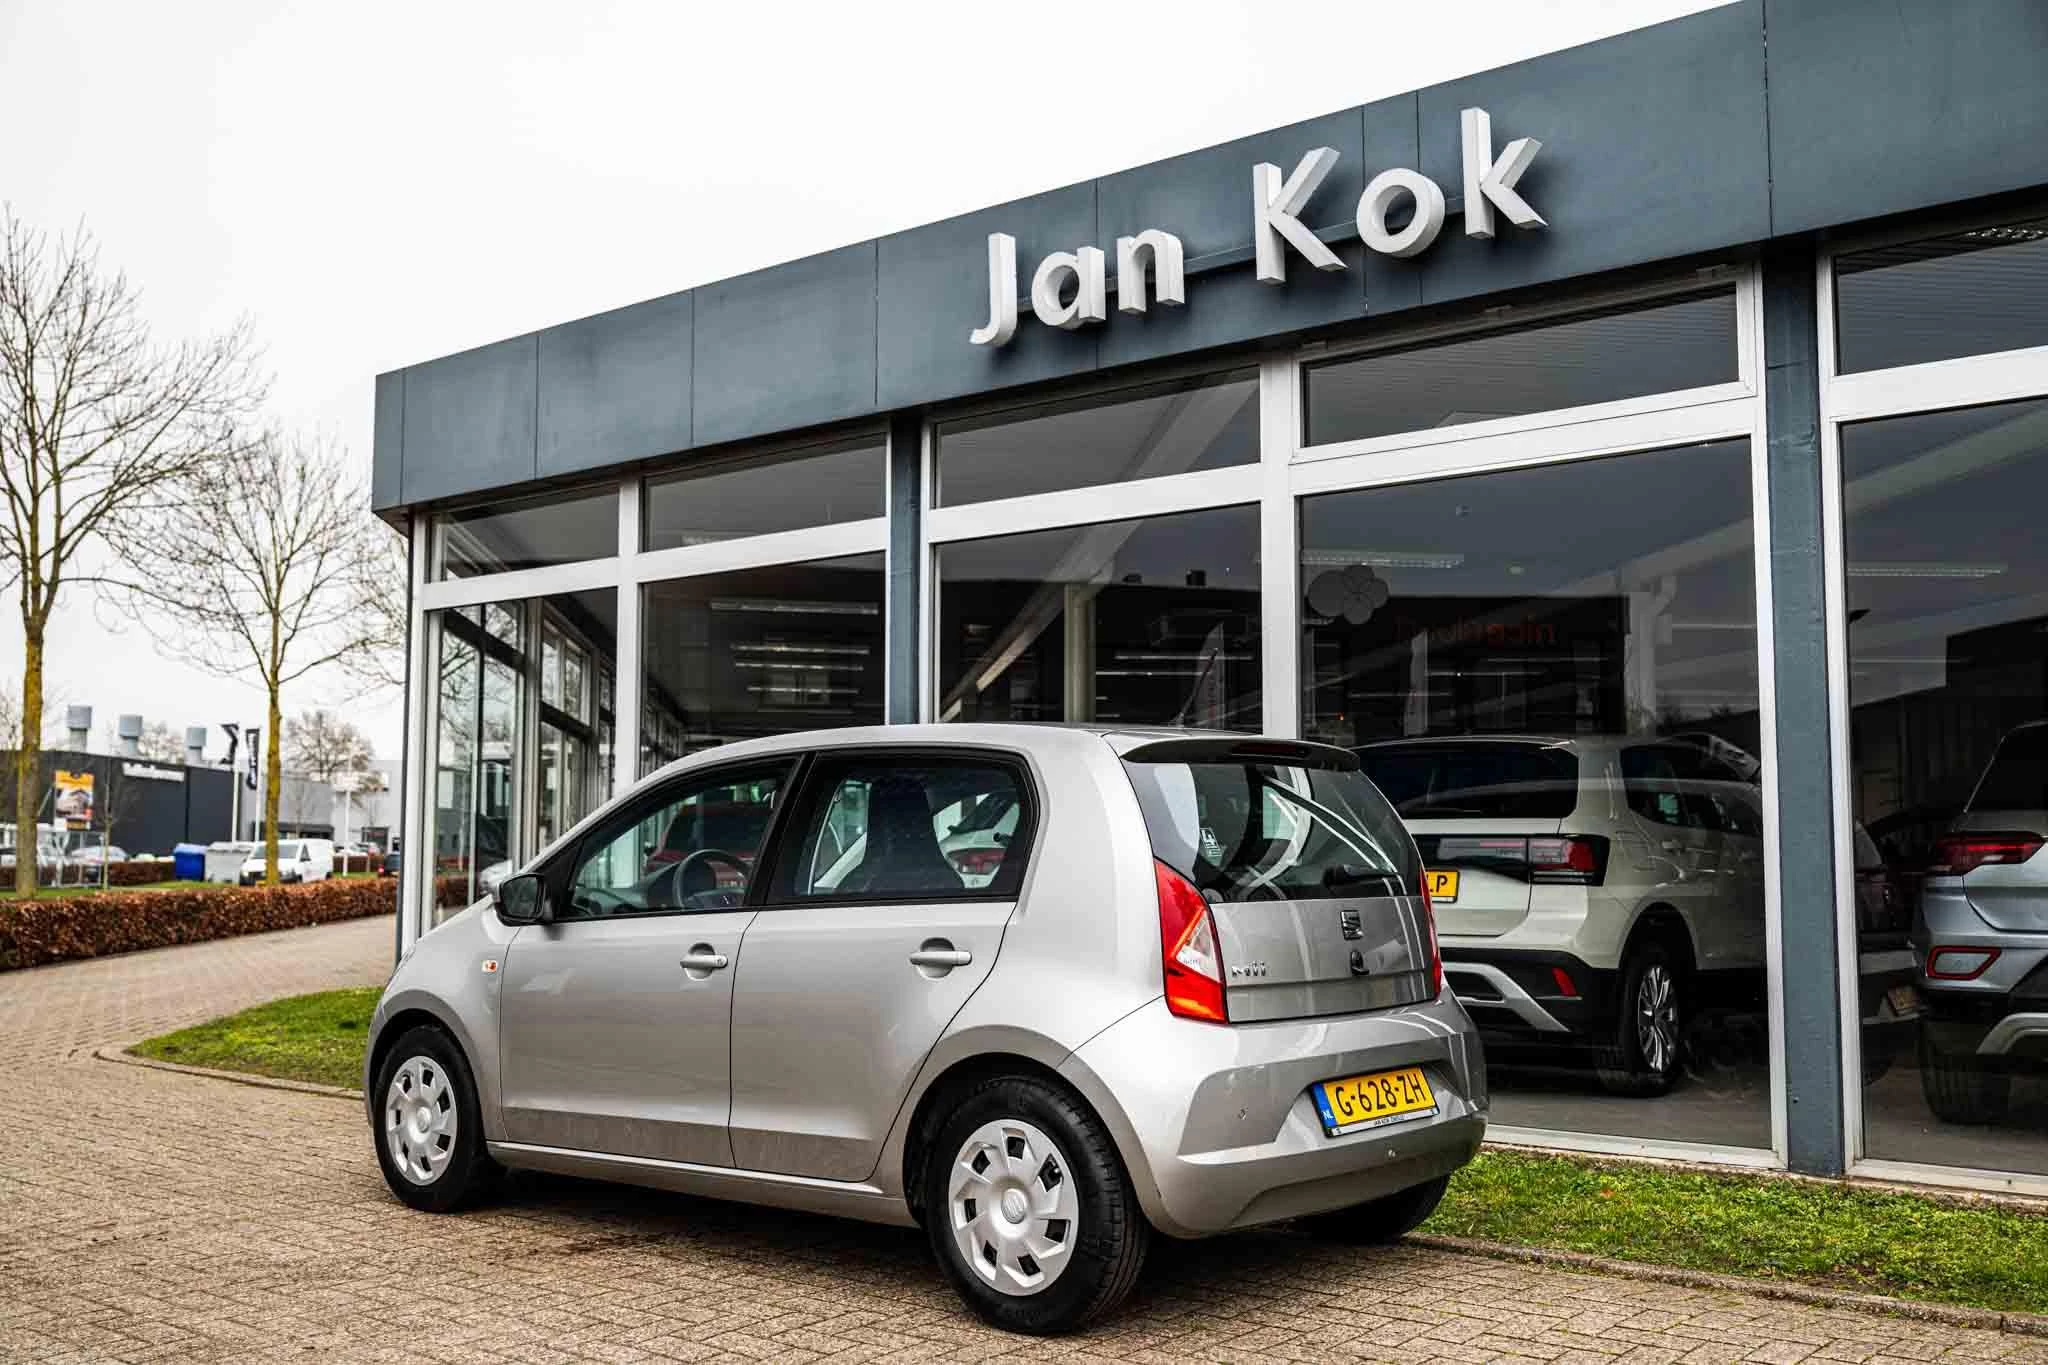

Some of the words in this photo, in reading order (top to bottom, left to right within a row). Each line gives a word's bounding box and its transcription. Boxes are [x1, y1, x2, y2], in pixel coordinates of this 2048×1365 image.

[970, 229, 1185, 348] Jan
[1252, 107, 1549, 285] Kok
[1323, 1110, 1334, 1121] NL
[1335, 1073, 1426, 1117] G-628-ZH
